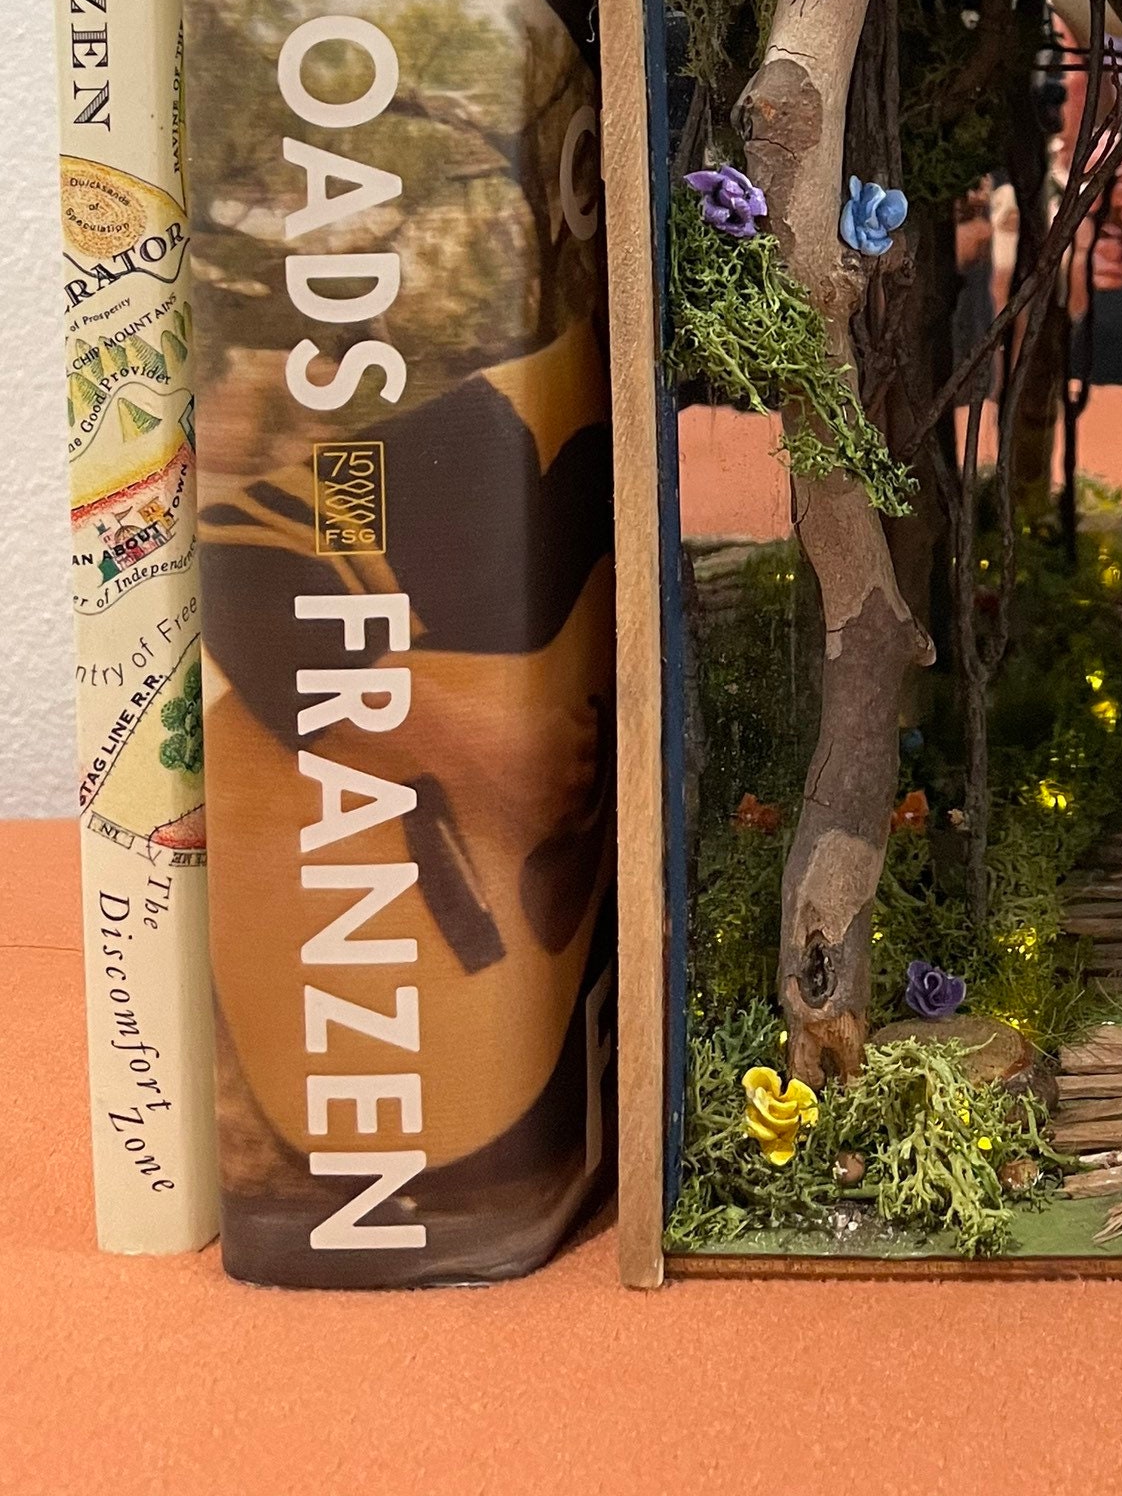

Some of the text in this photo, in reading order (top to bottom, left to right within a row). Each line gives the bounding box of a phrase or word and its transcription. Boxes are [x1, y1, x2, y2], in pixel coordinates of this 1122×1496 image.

[70, 177, 131, 207] Quicksands
[65, 207, 131, 233] Speculation
[64, 222, 184, 314] RATOR
[70, 297, 131, 333] of Prosperity
[72, 292, 178, 371] CHIP MOUNTAINS
[80, 391, 106, 433] Good
[100, 364, 172, 392] Provider
[323, 452, 374, 477] 75
[102, 521, 160, 560] ABOUT
[163, 463, 188, 520] TOWN
[326, 529, 376, 545] FSG
[96, 587, 111, 608] of
[131, 637, 155, 668] of
[79, 673, 164, 807] STAG LINE R.R.
[144, 876, 172, 930] The
[294, 593, 427, 1250] FRANZEN
[99, 890, 175, 1194] Discomfort Zone
